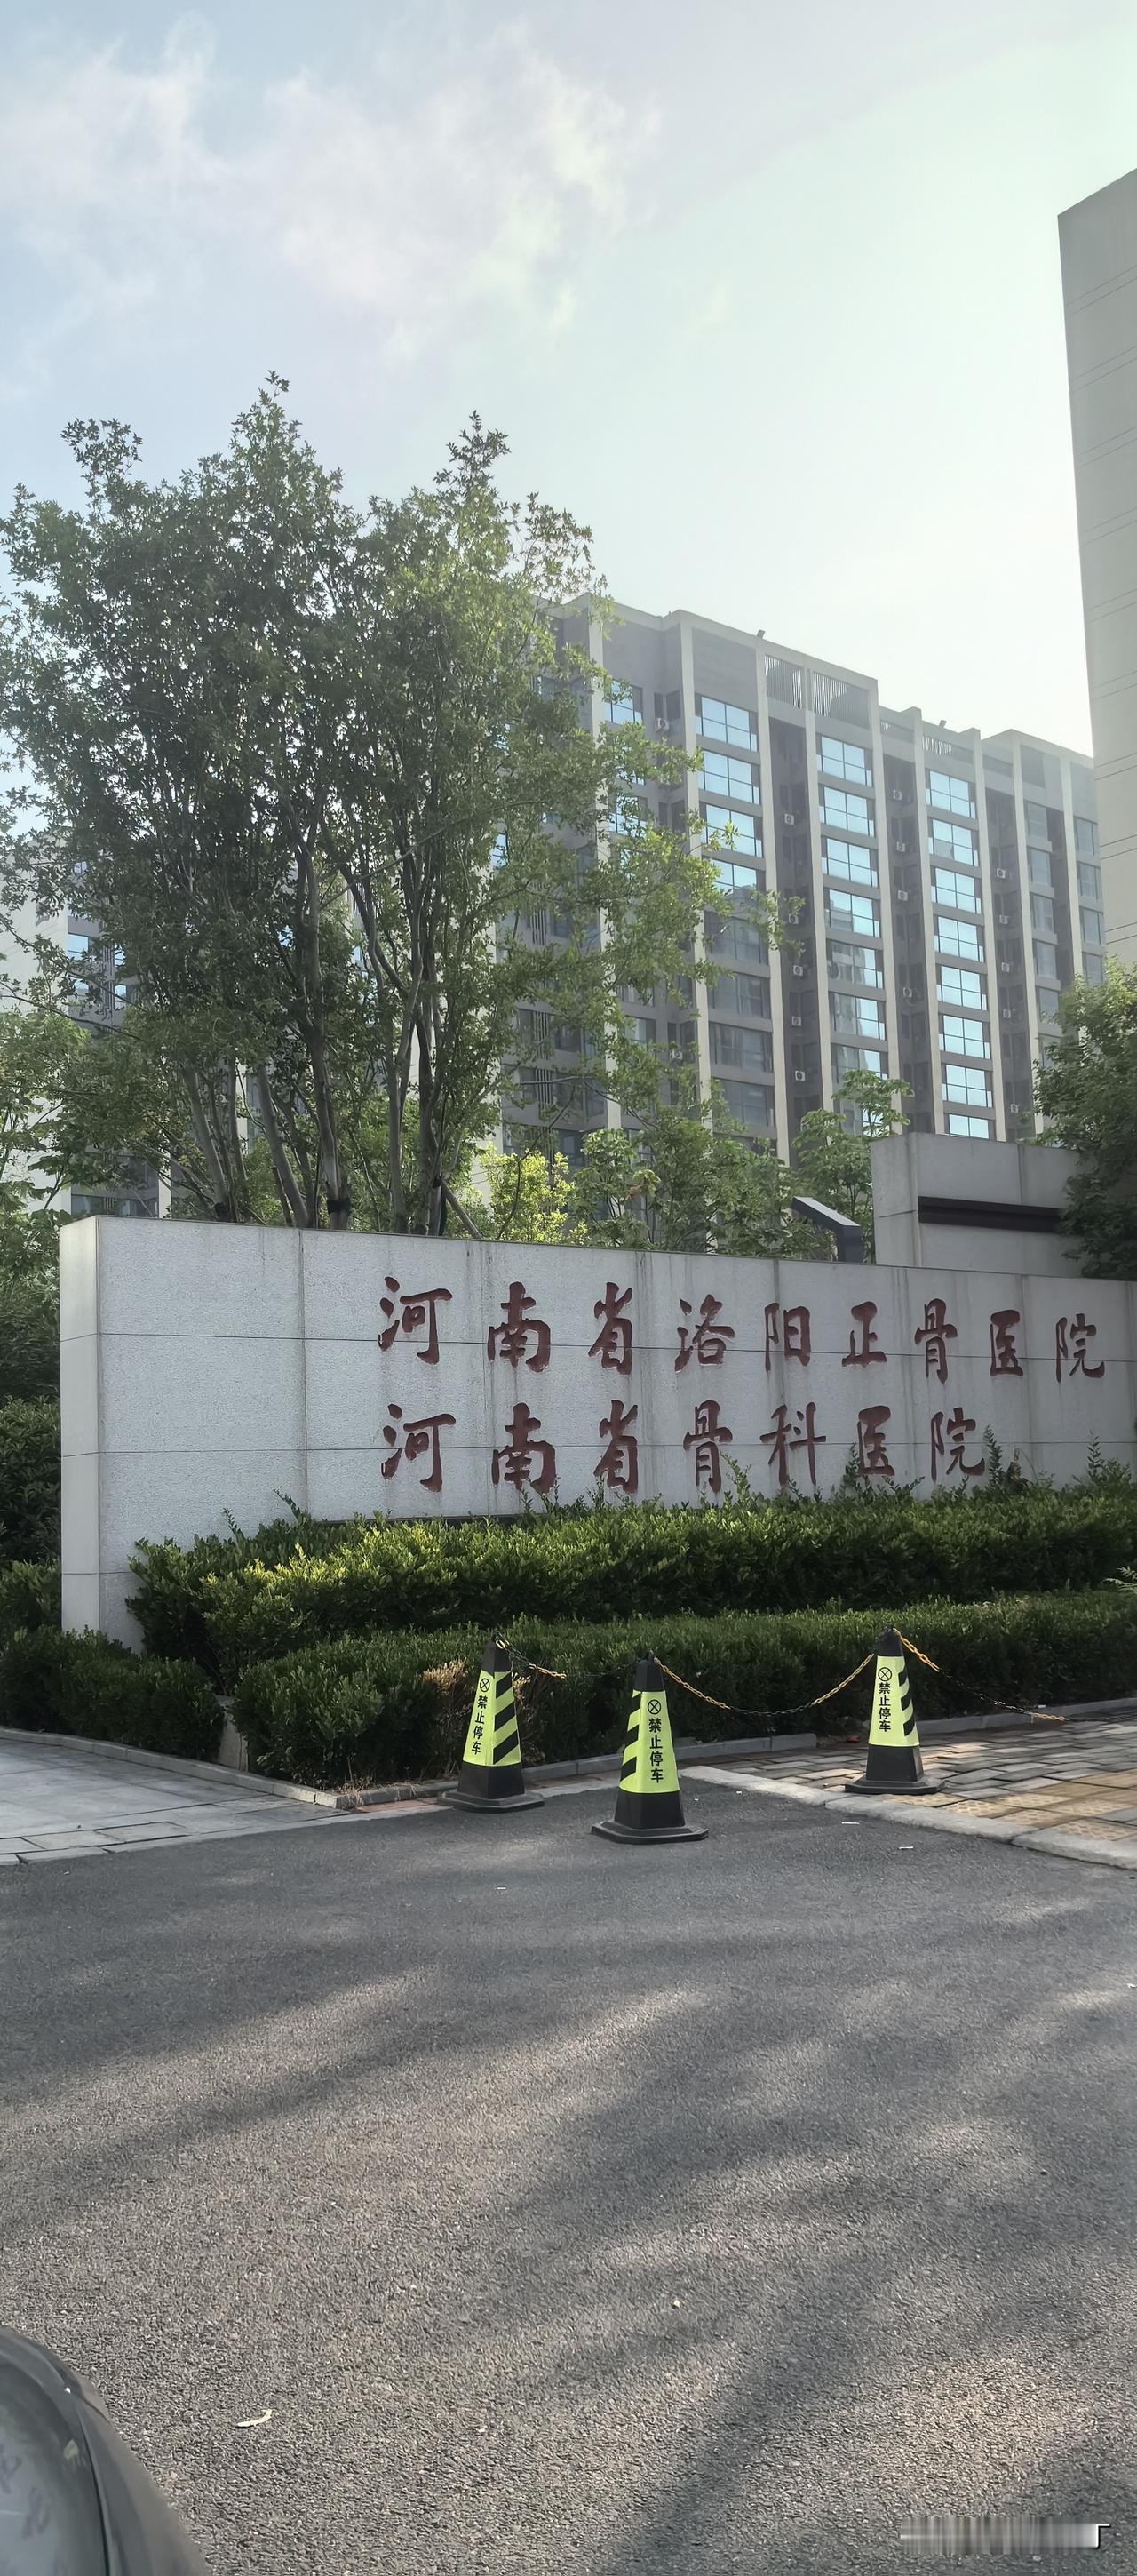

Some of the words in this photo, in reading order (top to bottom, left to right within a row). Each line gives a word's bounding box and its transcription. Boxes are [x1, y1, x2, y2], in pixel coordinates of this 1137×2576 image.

[378, 1277, 1105, 1384] 河南省洛阳正骨医院
[380, 1400, 985, 1494] 河南省骨科医院
[471, 1695, 488, 1755] 禁止停车
[879, 1682, 892, 1732] 禁止停车
[648, 1718, 664, 1783] 禁止停车
